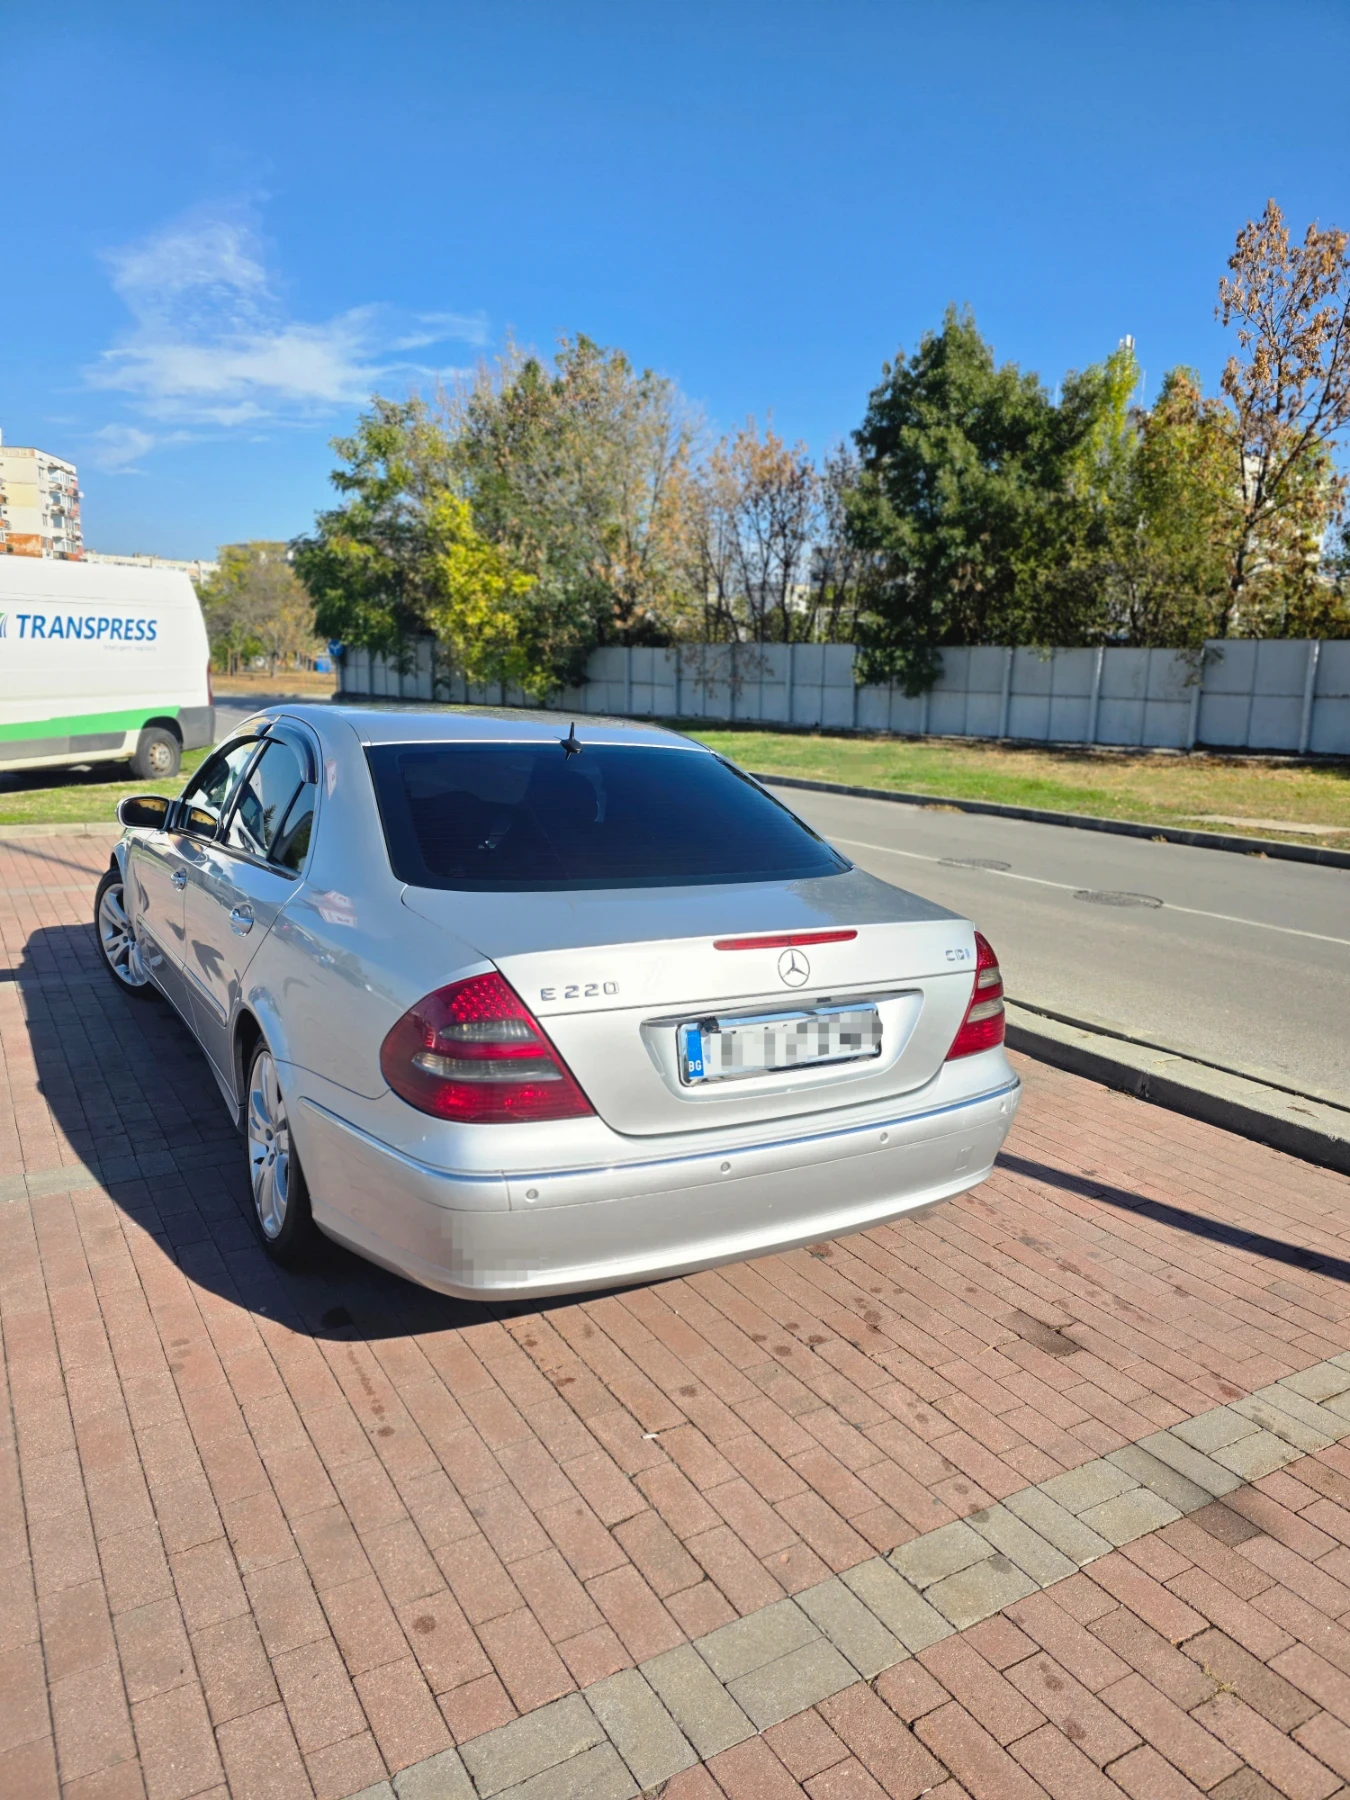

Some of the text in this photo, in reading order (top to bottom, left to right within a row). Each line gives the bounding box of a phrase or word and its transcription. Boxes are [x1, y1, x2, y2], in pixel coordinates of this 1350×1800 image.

[16, 614, 158, 641] TRANSPRESS
[945, 948, 971, 961] CDI
[540, 981, 619, 1001] E 220
[688, 1060, 702, 1072] BG
